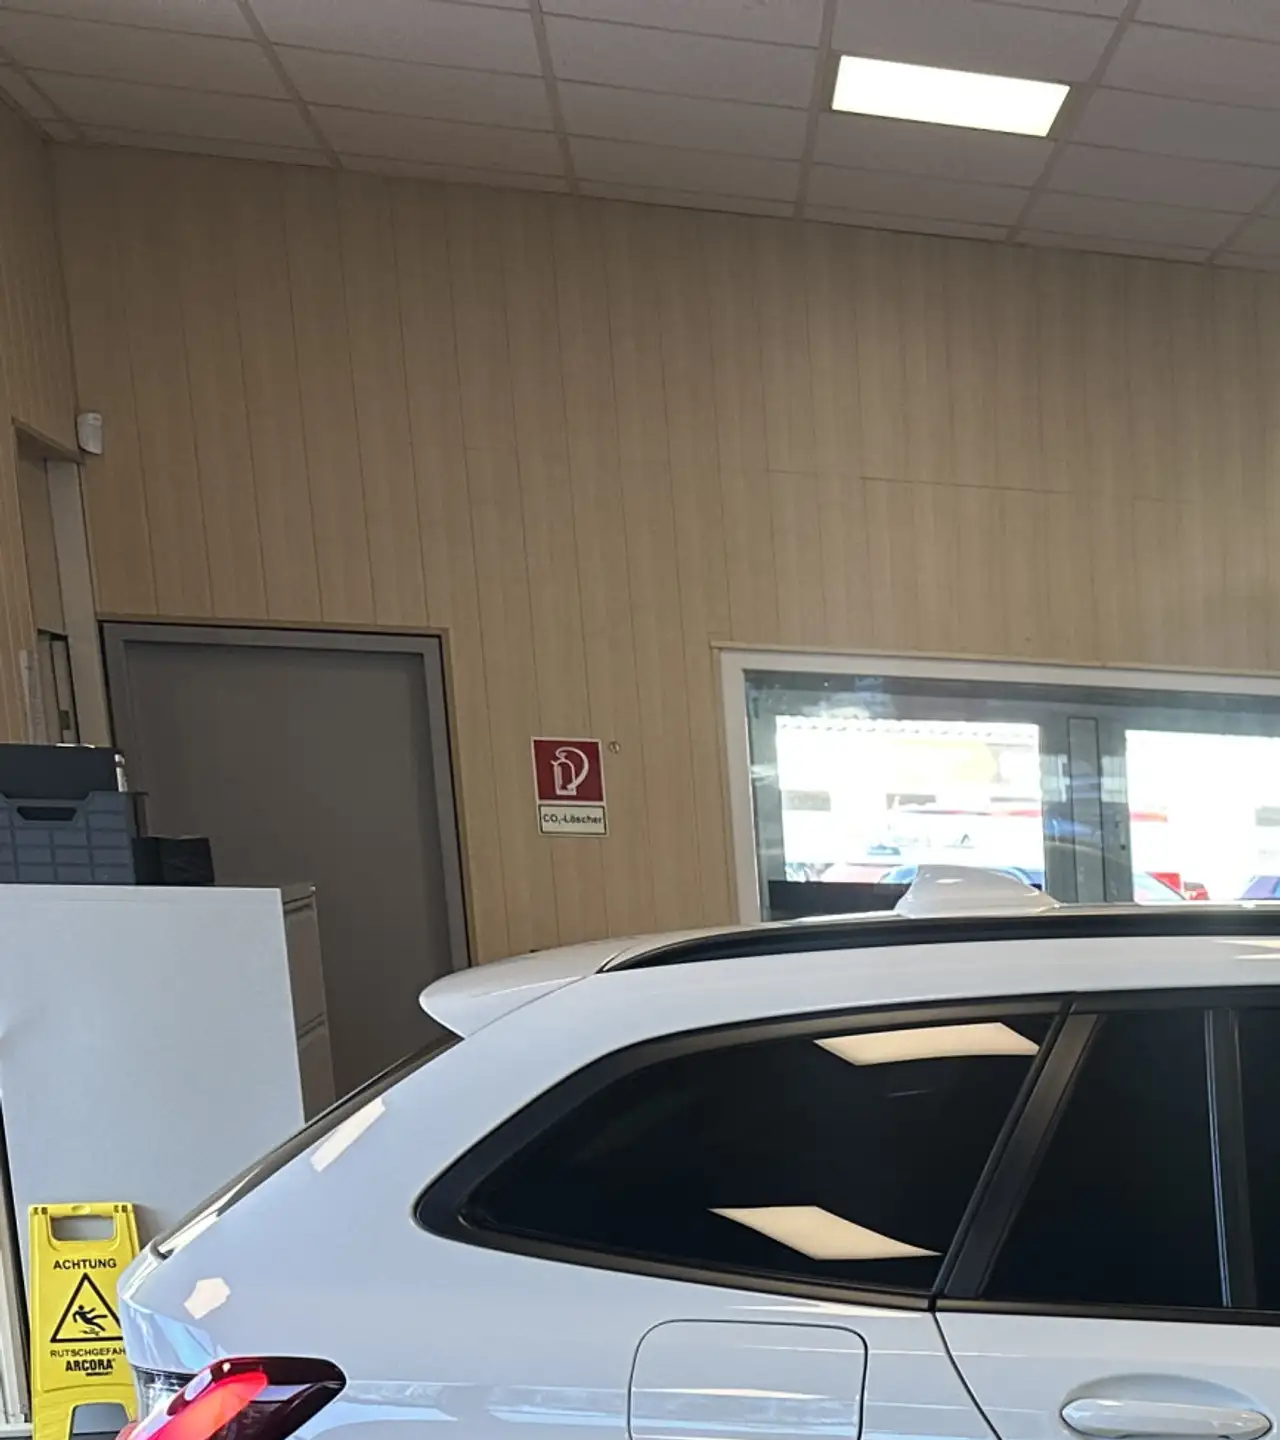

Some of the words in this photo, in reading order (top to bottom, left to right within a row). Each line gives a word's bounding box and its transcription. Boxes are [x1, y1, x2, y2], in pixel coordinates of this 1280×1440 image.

[53, 1258, 117, 1270] ACHTUNG
[50, 1347, 126, 1358] RUTSCHGEFAH
[65, 1359, 114, 1372] ARCORA
